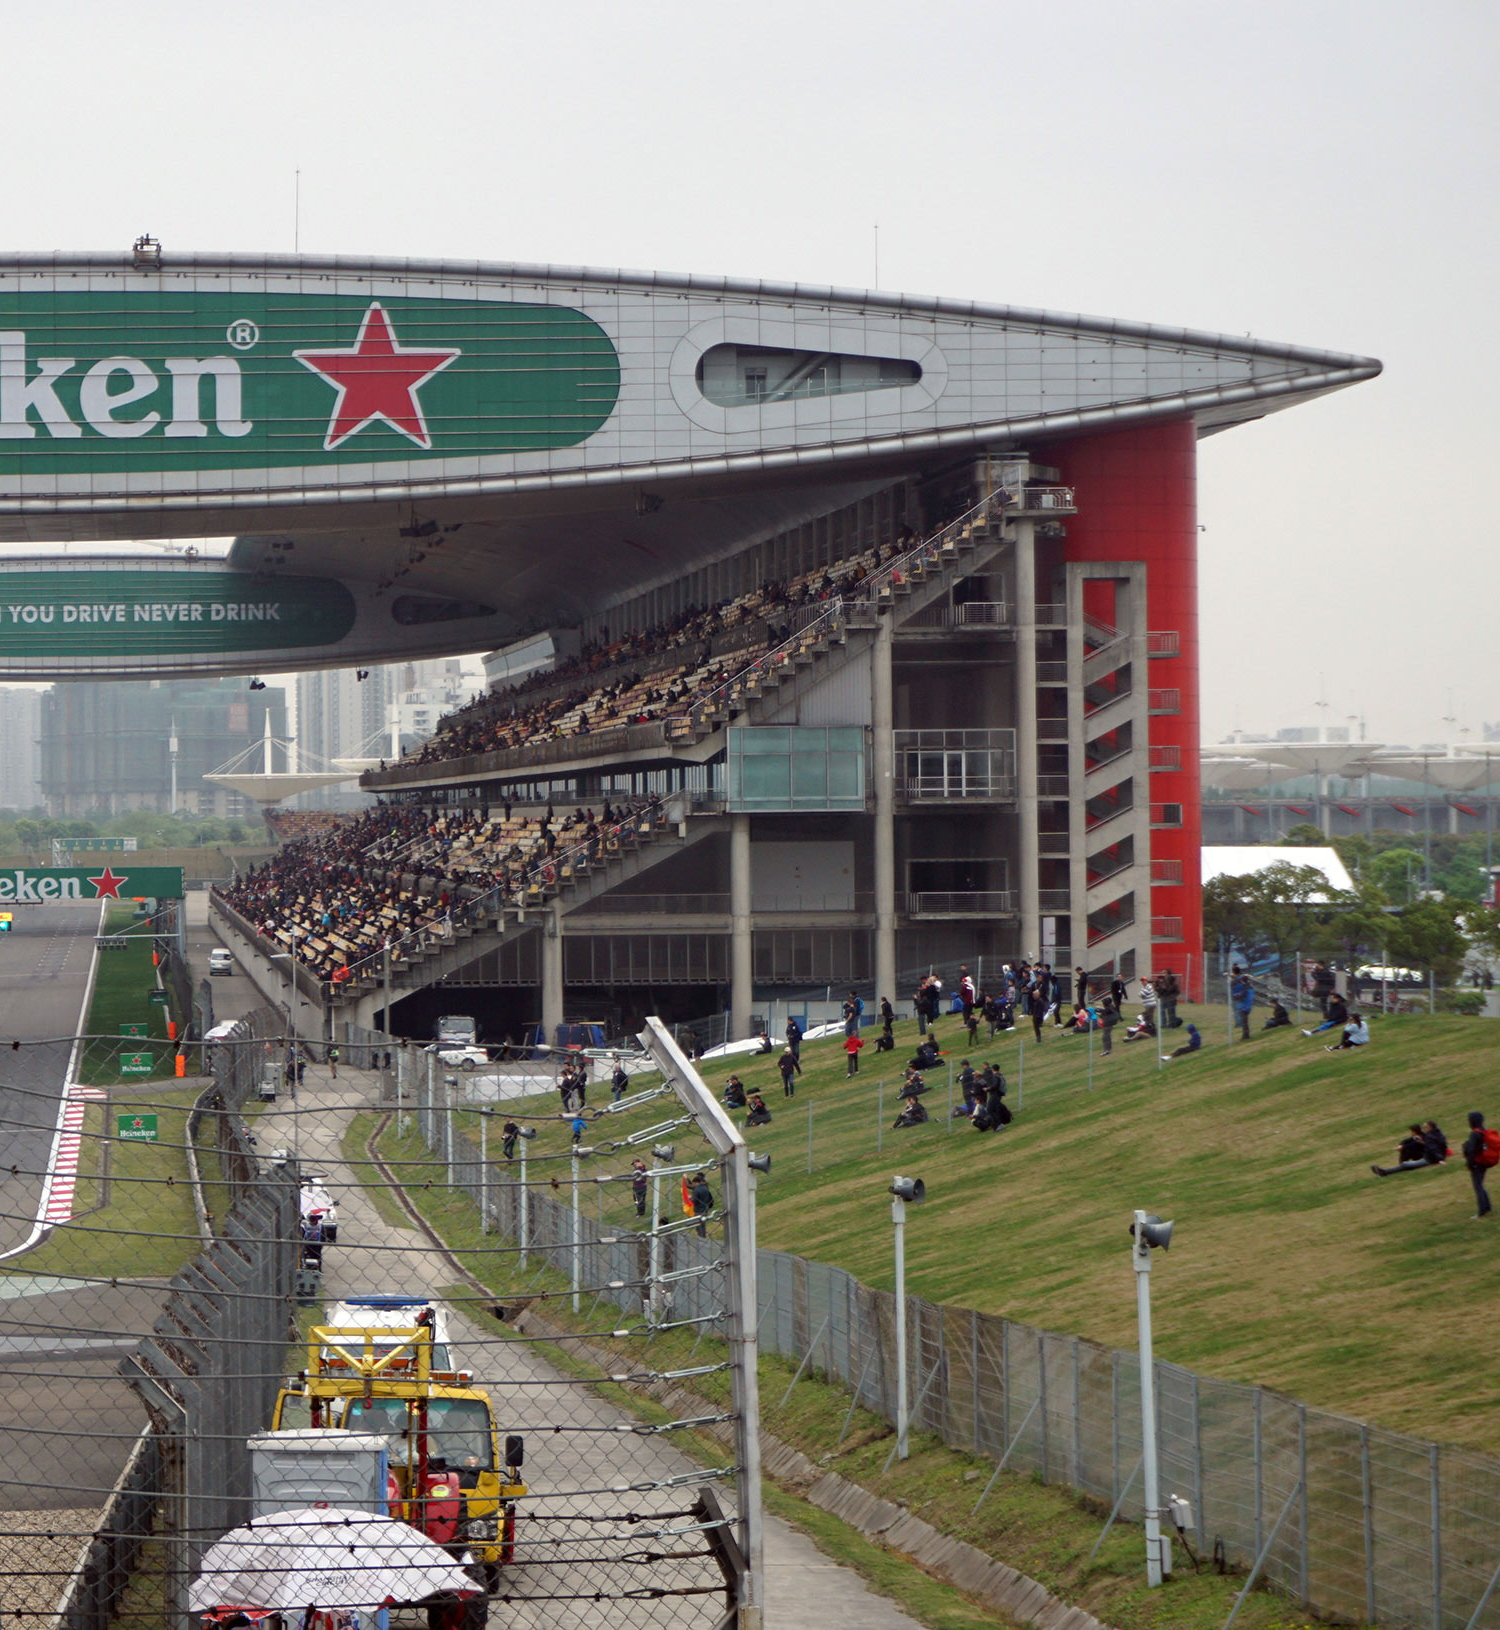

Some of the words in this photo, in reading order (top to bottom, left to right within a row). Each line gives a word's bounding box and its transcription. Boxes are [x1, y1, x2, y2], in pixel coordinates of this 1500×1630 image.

[8, 605, 54, 624] YOU
[64, 604, 126, 623] DRIVE
[134, 603, 203, 622] NEVER
[211, 603, 281, 621] DRINK
[119, 1129, 156, 1138] Heineken
